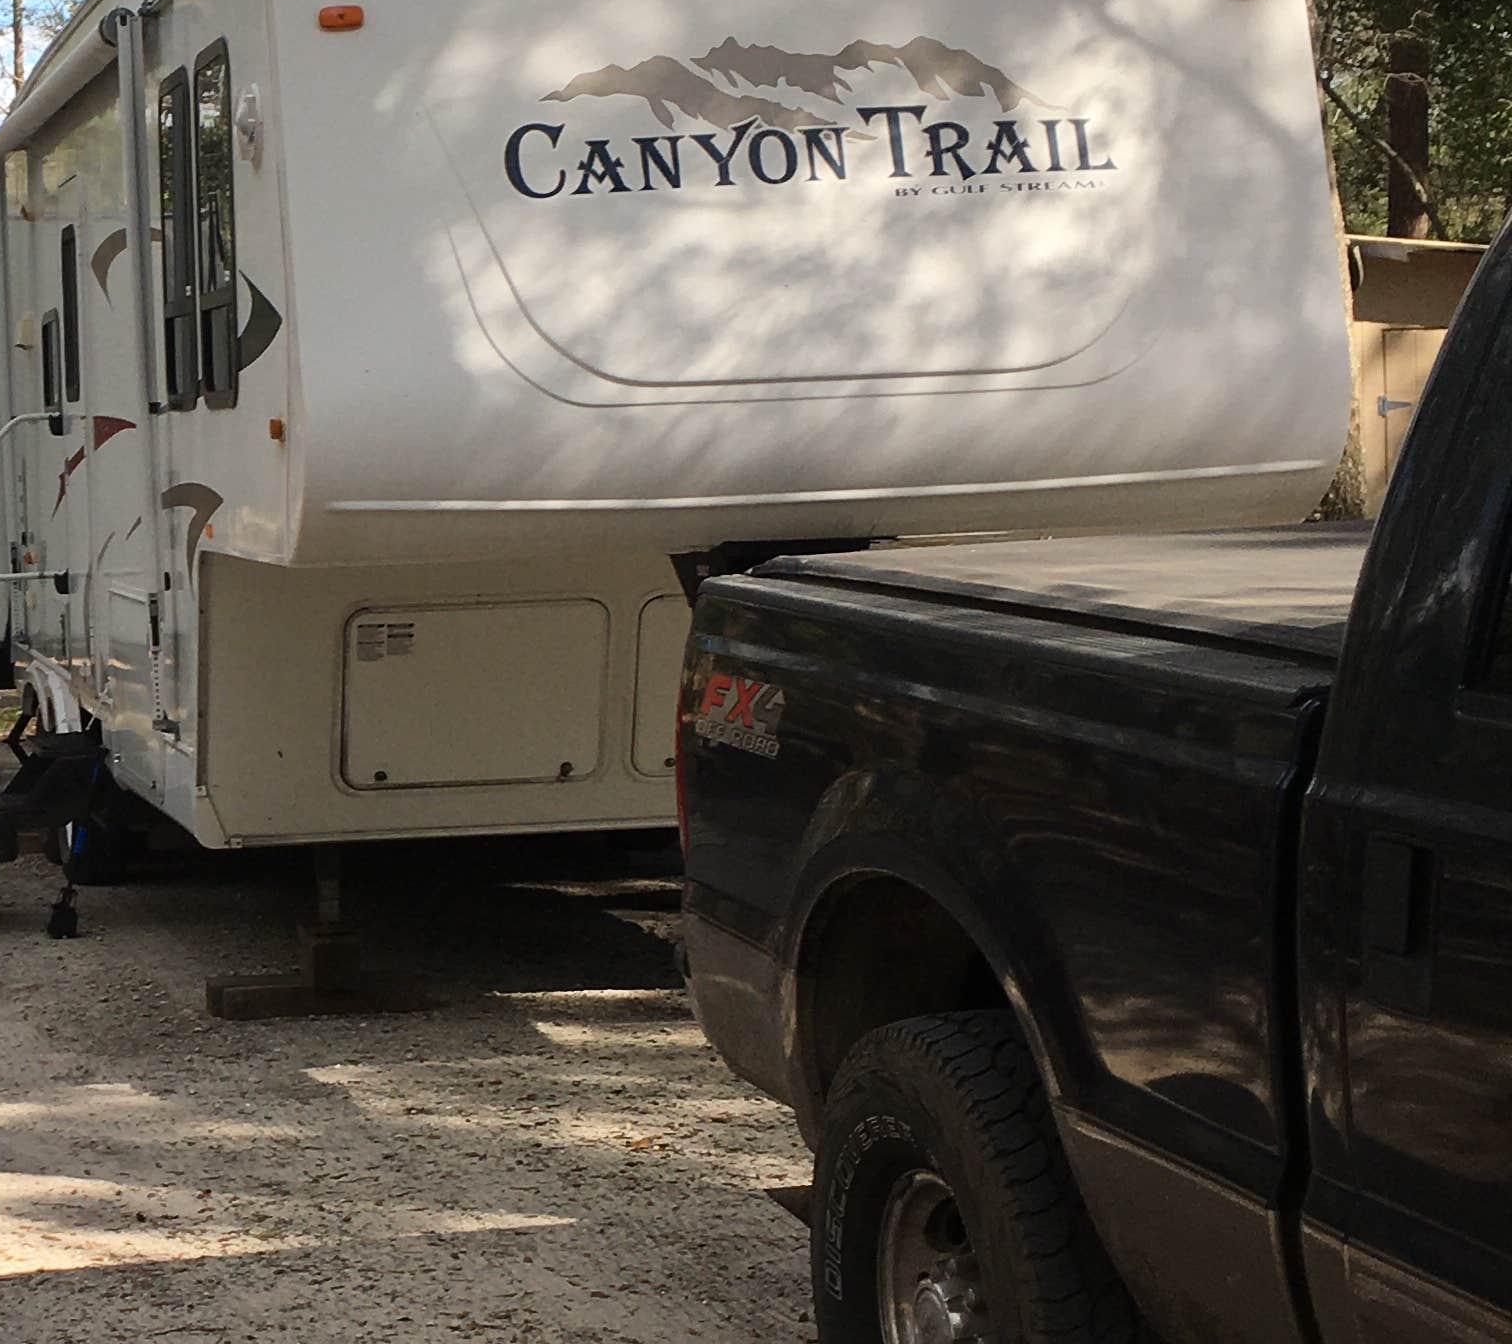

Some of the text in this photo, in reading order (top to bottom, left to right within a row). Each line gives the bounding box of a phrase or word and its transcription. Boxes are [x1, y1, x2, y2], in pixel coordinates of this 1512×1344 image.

[503, 105, 1119, 200] CANYON TRAIL
[895, 179, 1096, 197] BY GULF STREAM
[698, 672, 788, 737] FX4
[730, 727, 781, 757] ROAD
